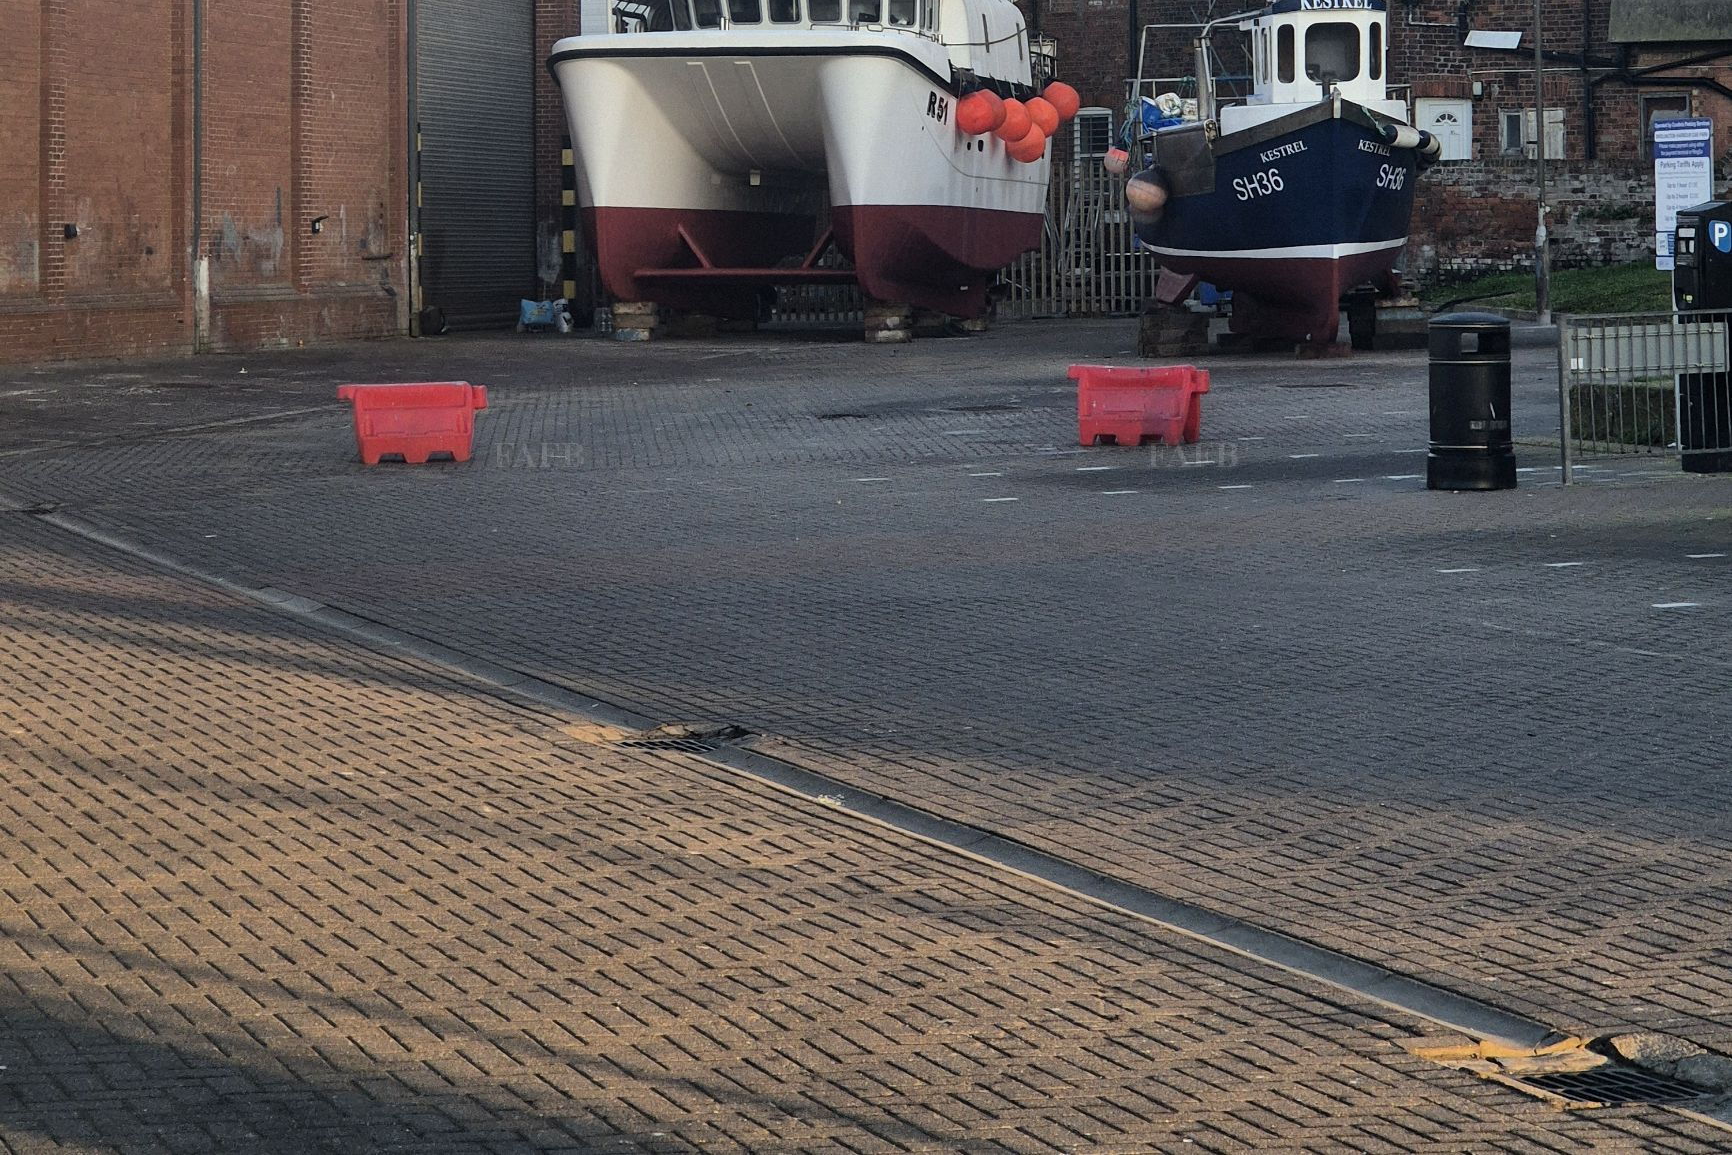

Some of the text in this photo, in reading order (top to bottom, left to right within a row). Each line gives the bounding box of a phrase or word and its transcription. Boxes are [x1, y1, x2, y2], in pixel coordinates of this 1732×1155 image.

[1259, 140, 1308, 163] KESTREL
[1358, 139, 1391, 157] KESTREL
[1660, 160, 1676, 170] Parking
[1691, 159, 1704, 169] Apply
[1232, 168, 1284, 201] SH36
[1376, 164, 1407, 191] SH36
[1714, 223, 1728, 247] P
